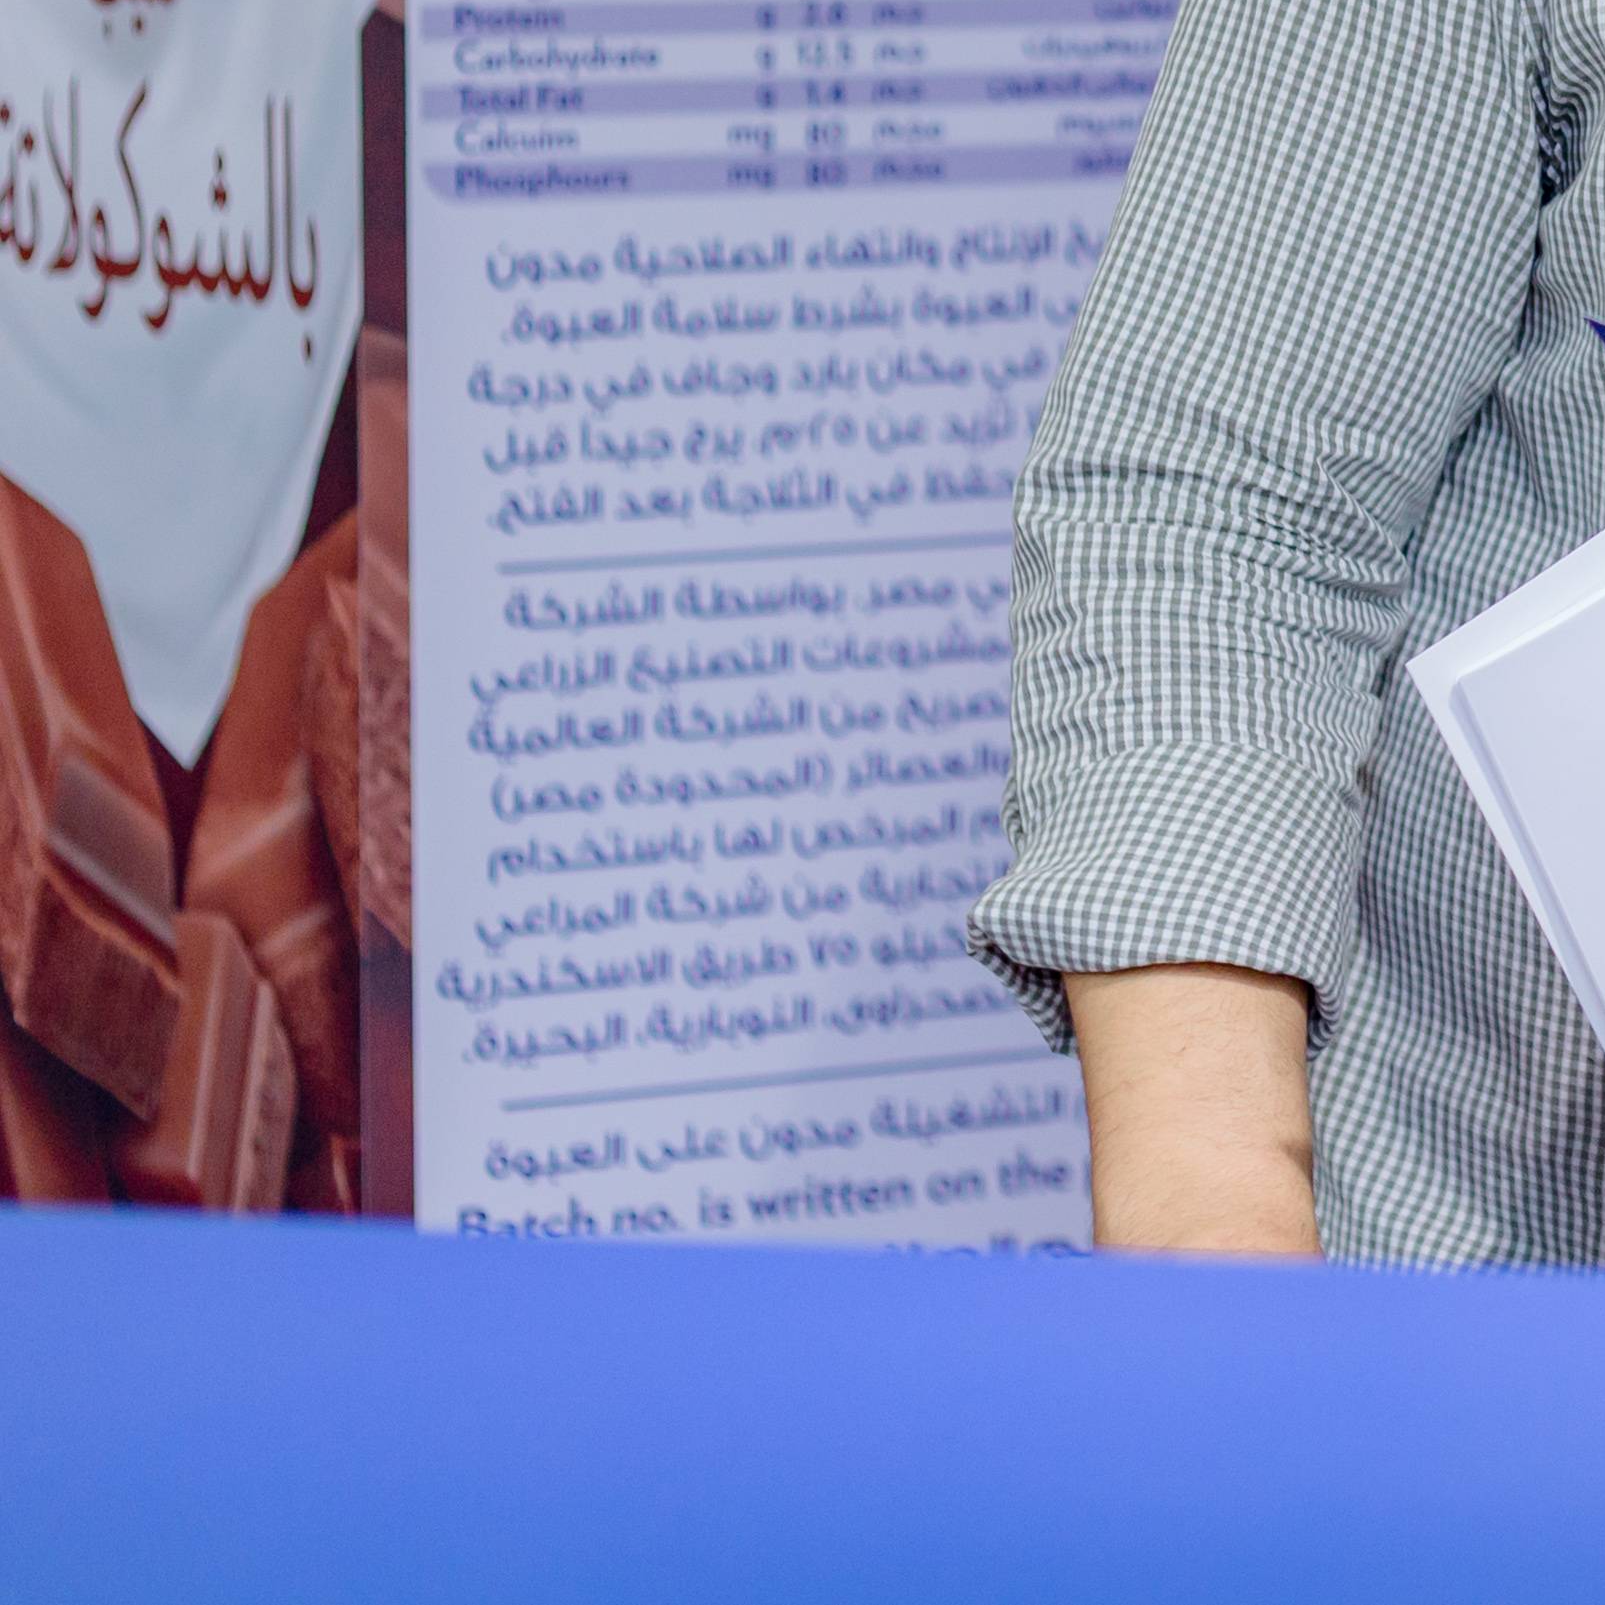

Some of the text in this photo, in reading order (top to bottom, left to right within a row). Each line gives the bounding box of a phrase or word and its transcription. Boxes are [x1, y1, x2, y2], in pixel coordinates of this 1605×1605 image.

[748, 1166, 918, 1222] written
[928, 1172, 986, 1204] on
[995, 1145, 1071, 1194] the
